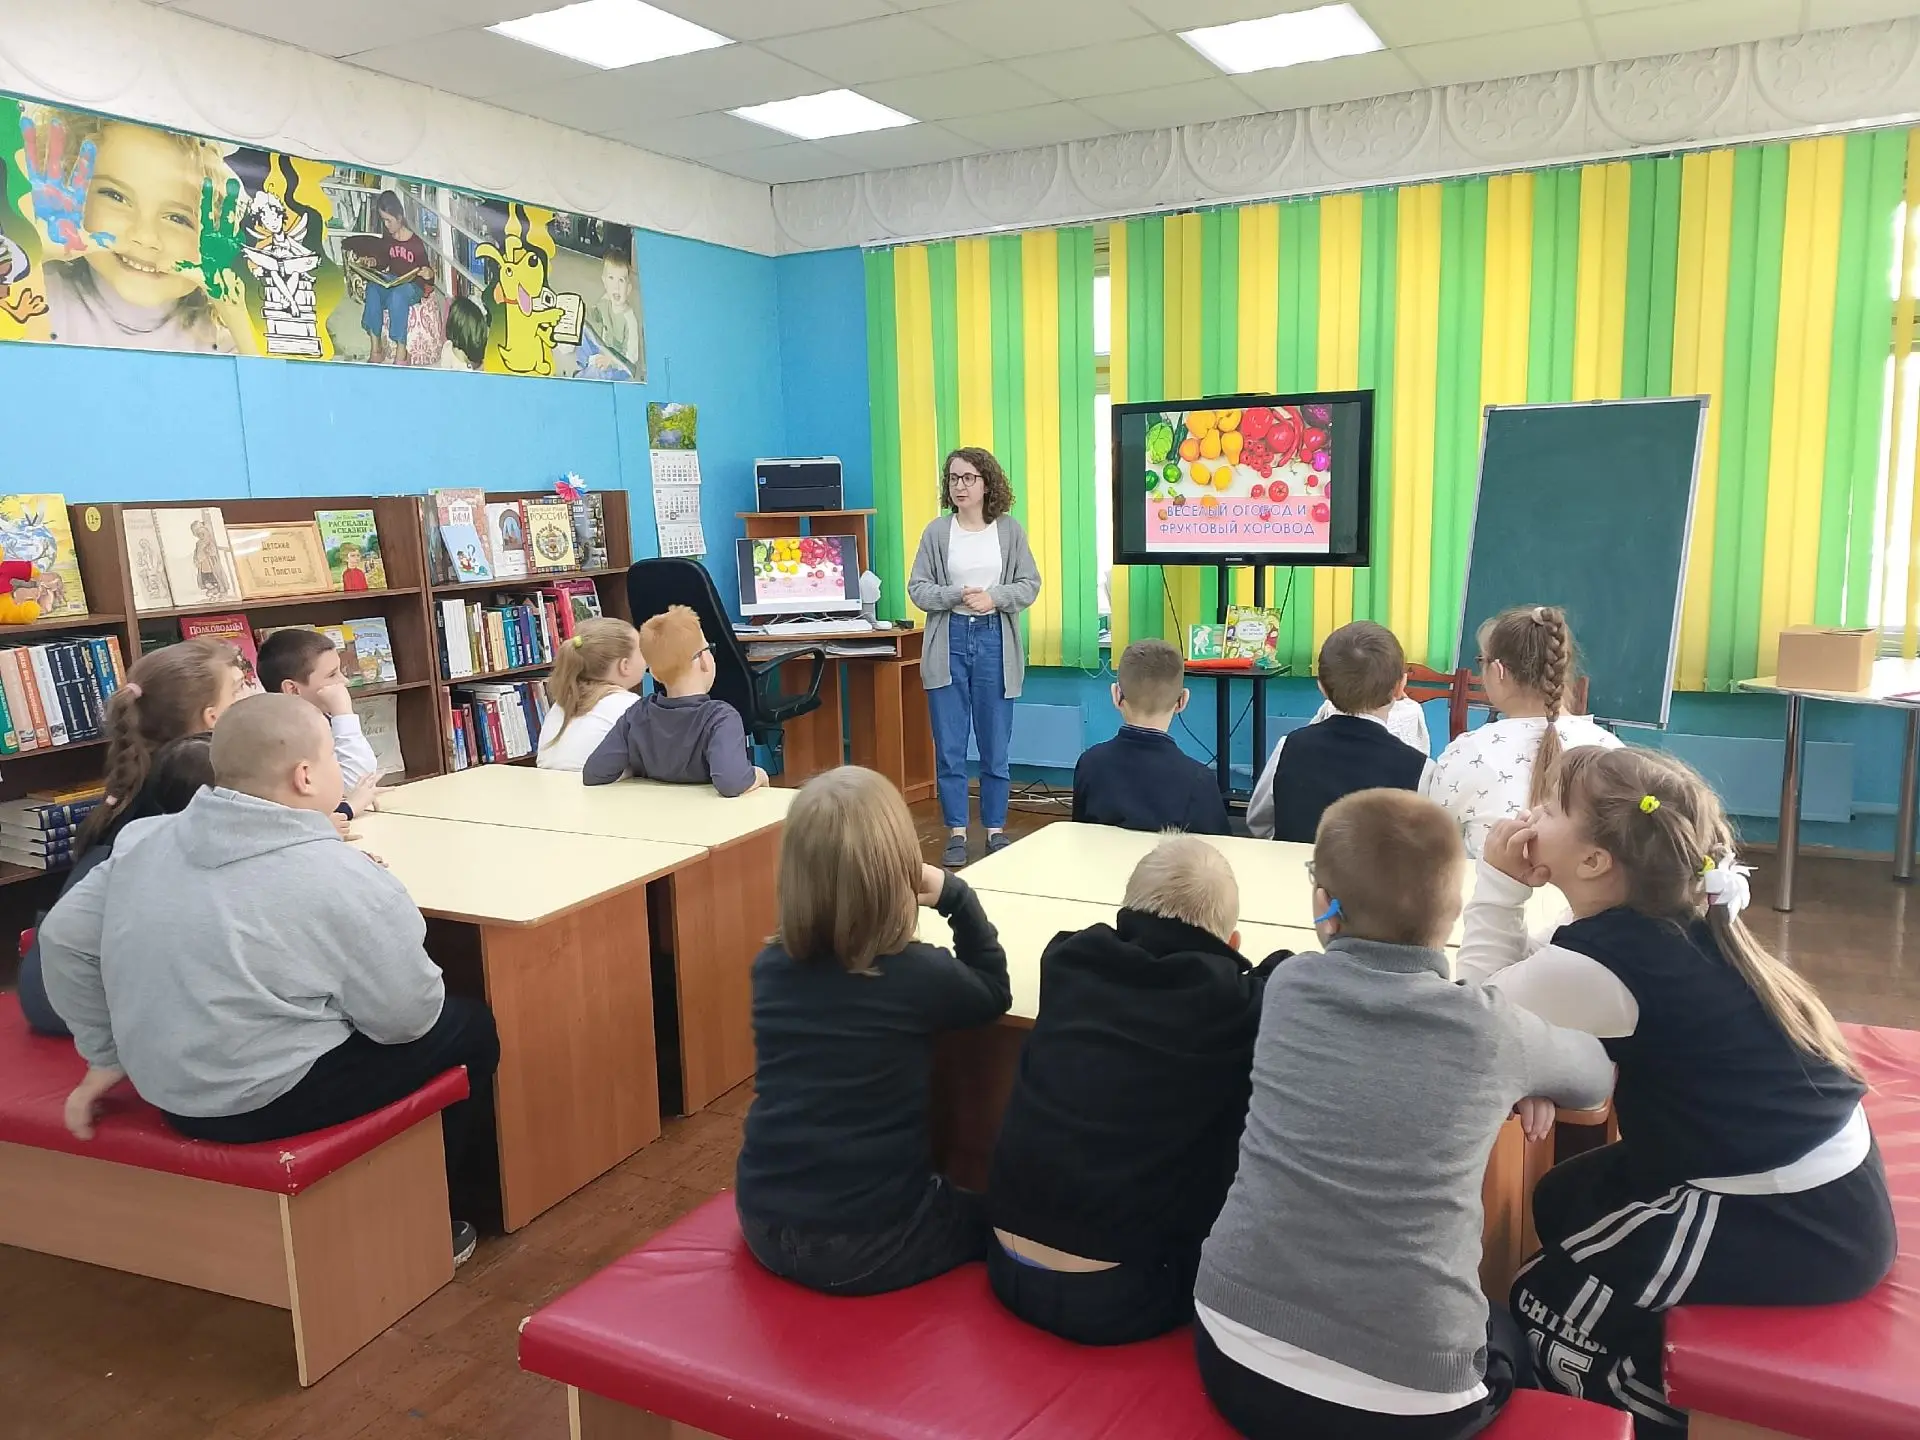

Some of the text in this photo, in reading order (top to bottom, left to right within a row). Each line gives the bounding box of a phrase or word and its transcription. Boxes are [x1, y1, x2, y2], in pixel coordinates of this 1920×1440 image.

[1232, 504, 1293, 517] ОГОРОД
[1297, 504, 1307, 516] И
[529, 511, 568, 521] РОССИИ
[328, 520, 368, 528] РАССКАЗЫ
[1159, 520, 1315, 535] ФРУКТОВЫЙ ХОРОВОД
[337, 526, 367, 534] СКАЗКИ
[261, 541, 290, 551] Детские
[262, 555, 297, 567] страницы
[272, 566, 303, 577] Толстого
